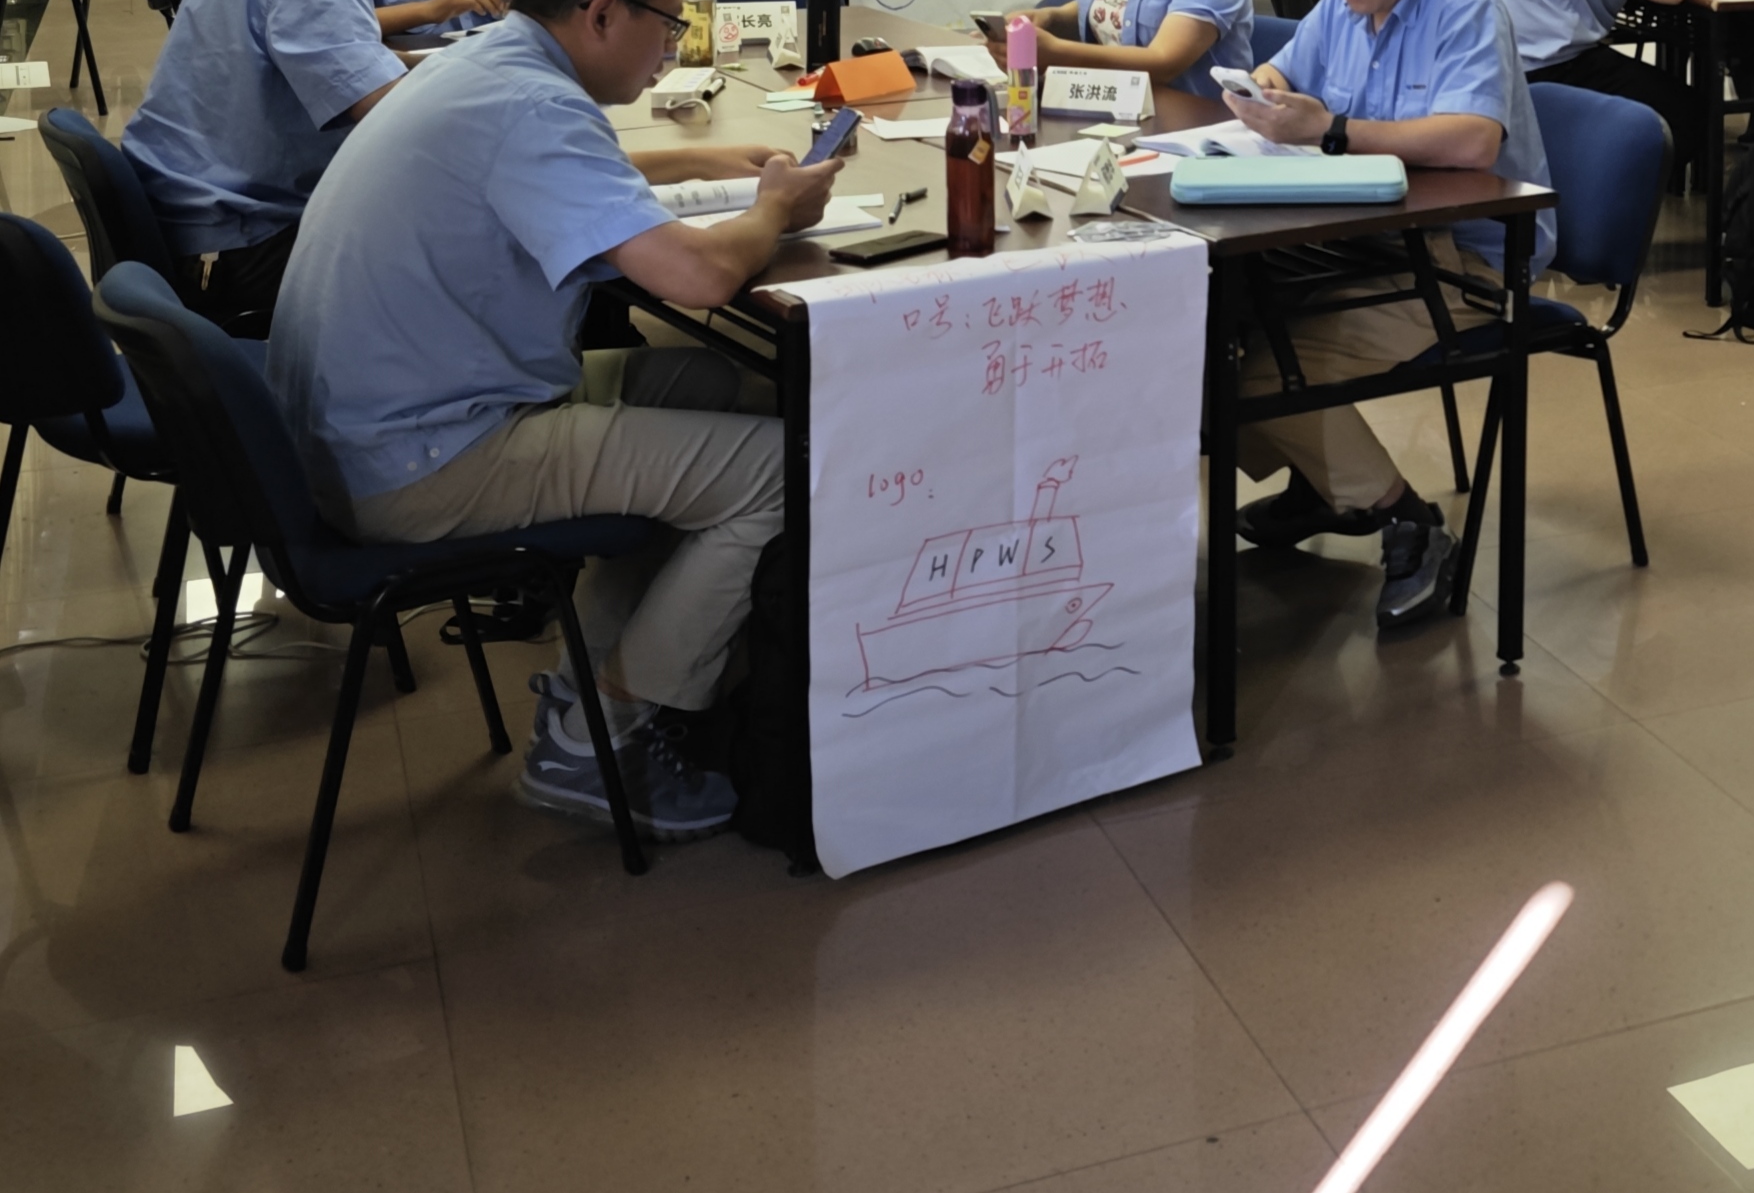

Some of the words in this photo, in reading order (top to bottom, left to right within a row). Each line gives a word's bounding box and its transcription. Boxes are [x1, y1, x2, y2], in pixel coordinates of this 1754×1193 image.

[737, 14, 773, 28] 长亮
[1069, 83, 1117, 102] 张洪流
[981, 339, 1109, 396] 勇于开拓
